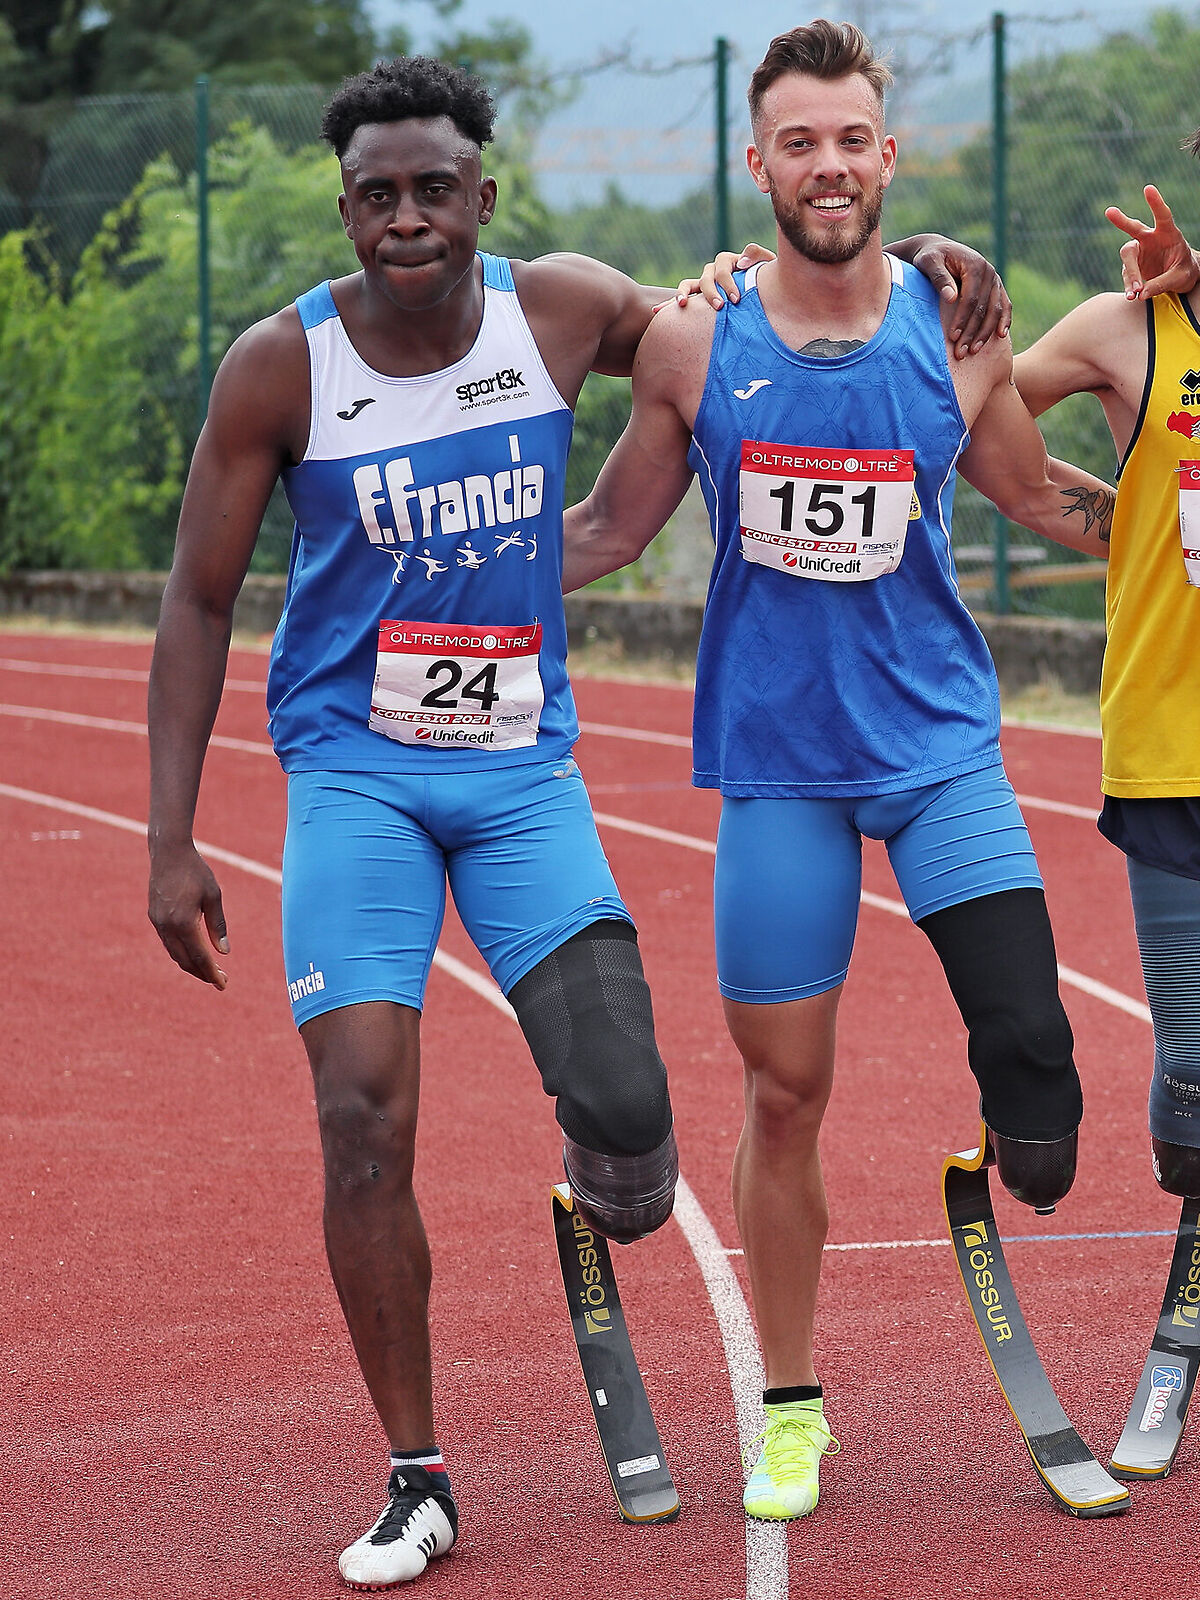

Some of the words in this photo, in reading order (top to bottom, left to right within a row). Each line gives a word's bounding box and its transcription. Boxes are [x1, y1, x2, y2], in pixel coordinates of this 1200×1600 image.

[456, 368, 526, 402] sport3k
[459, 390, 530, 411] www.sport3k.com
[769, 481, 877, 538] 151
[745, 530, 815, 550] CONCESIO
[815, 544, 855, 553] 2021
[798, 555, 862, 574] UniCredit
[420, 660, 500, 711] 24
[376, 709, 451, 725] CONCESIO
[451, 715, 489, 725] 2021
[432, 729, 495, 744] UniCredit
[1147, 1388, 1171, 1429] ROGA
